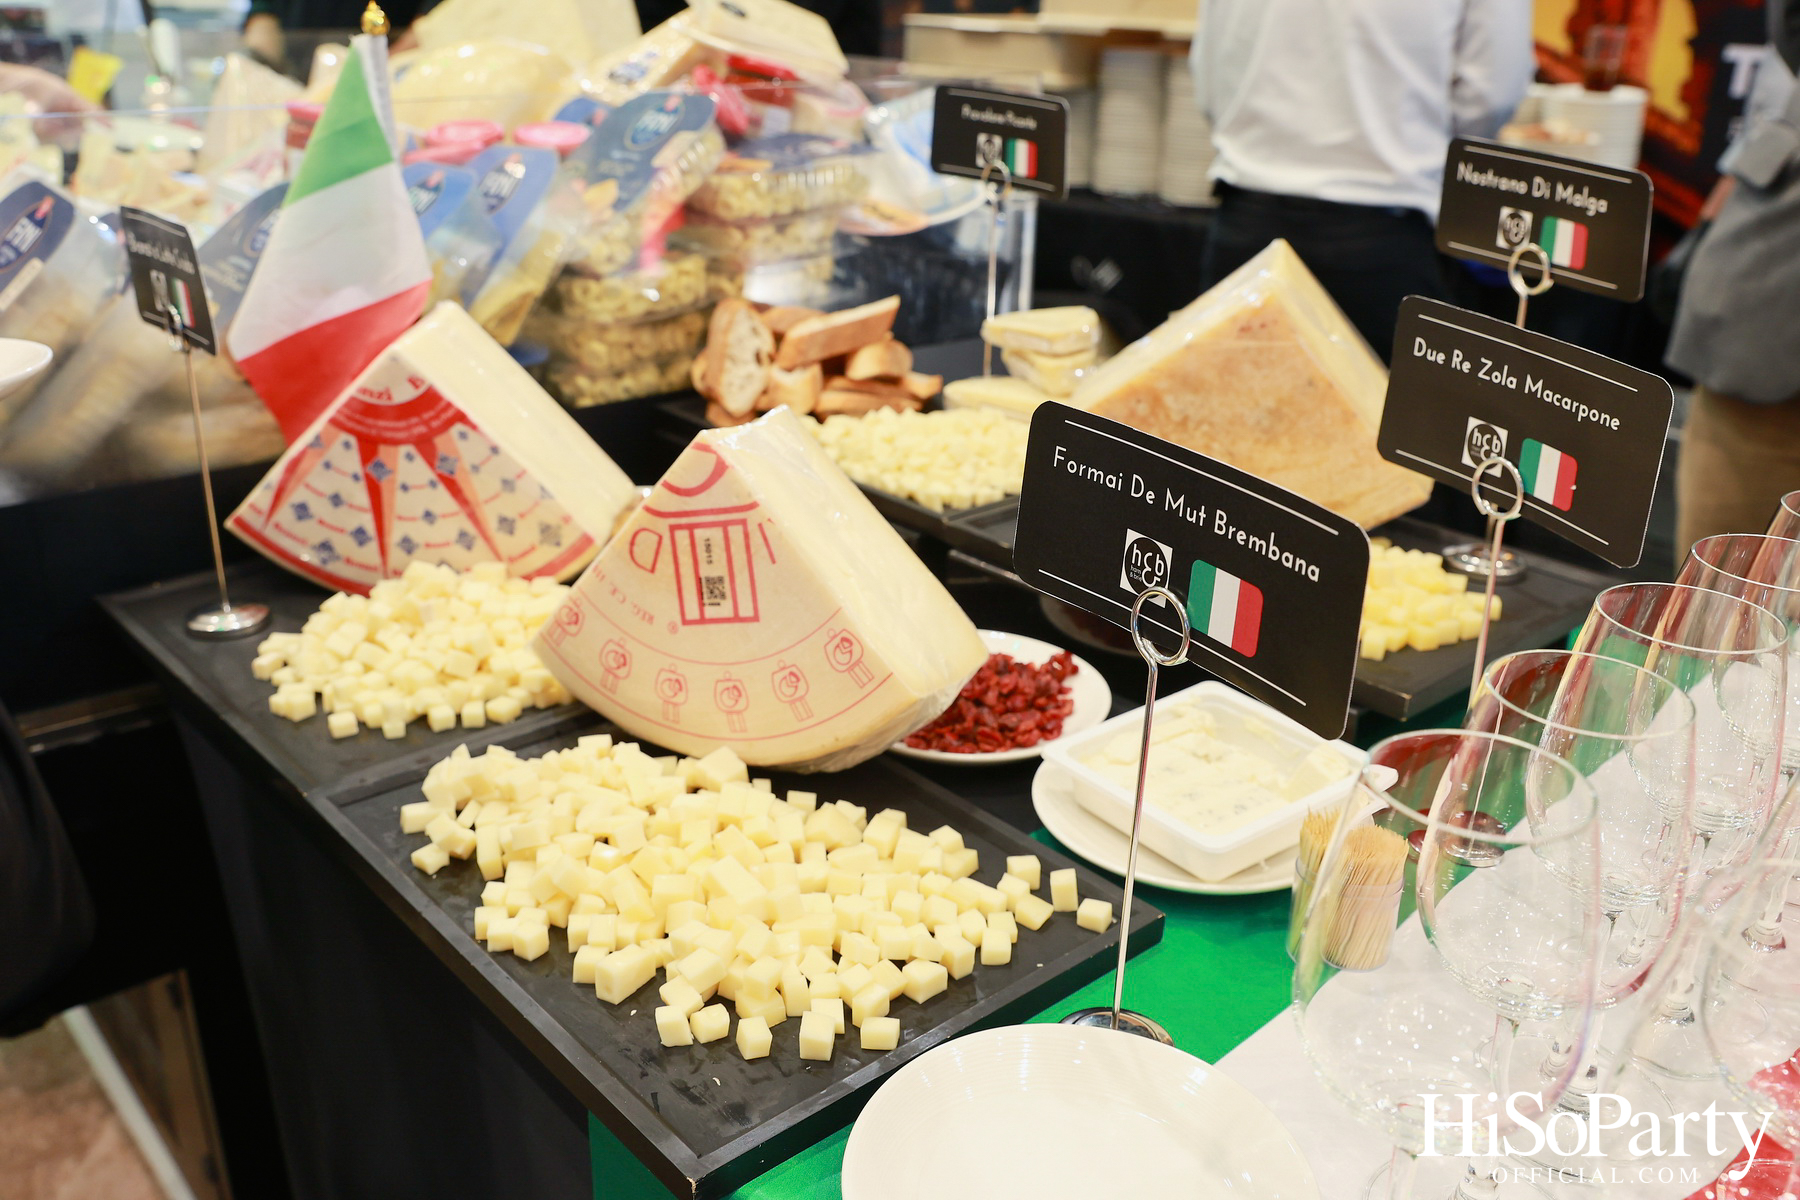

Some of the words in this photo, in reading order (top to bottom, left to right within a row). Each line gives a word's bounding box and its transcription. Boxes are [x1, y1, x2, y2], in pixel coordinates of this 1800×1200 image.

[1456, 161, 1528, 195] Nostrano
[1531, 176, 1551, 199] Di
[1555, 181, 1608, 217] Malga
[1413, 337, 1446, 365] Due
[1451, 349, 1472, 373] Re
[1477, 357, 1518, 389] Zola
[1524, 374, 1620, 431] Macarpone
[1053, 445, 1123, 491] Formai
[1130, 473, 1156, 504] De
[1165, 487, 1207, 526] Mut
[1213, 509, 1321, 582] Brembana
